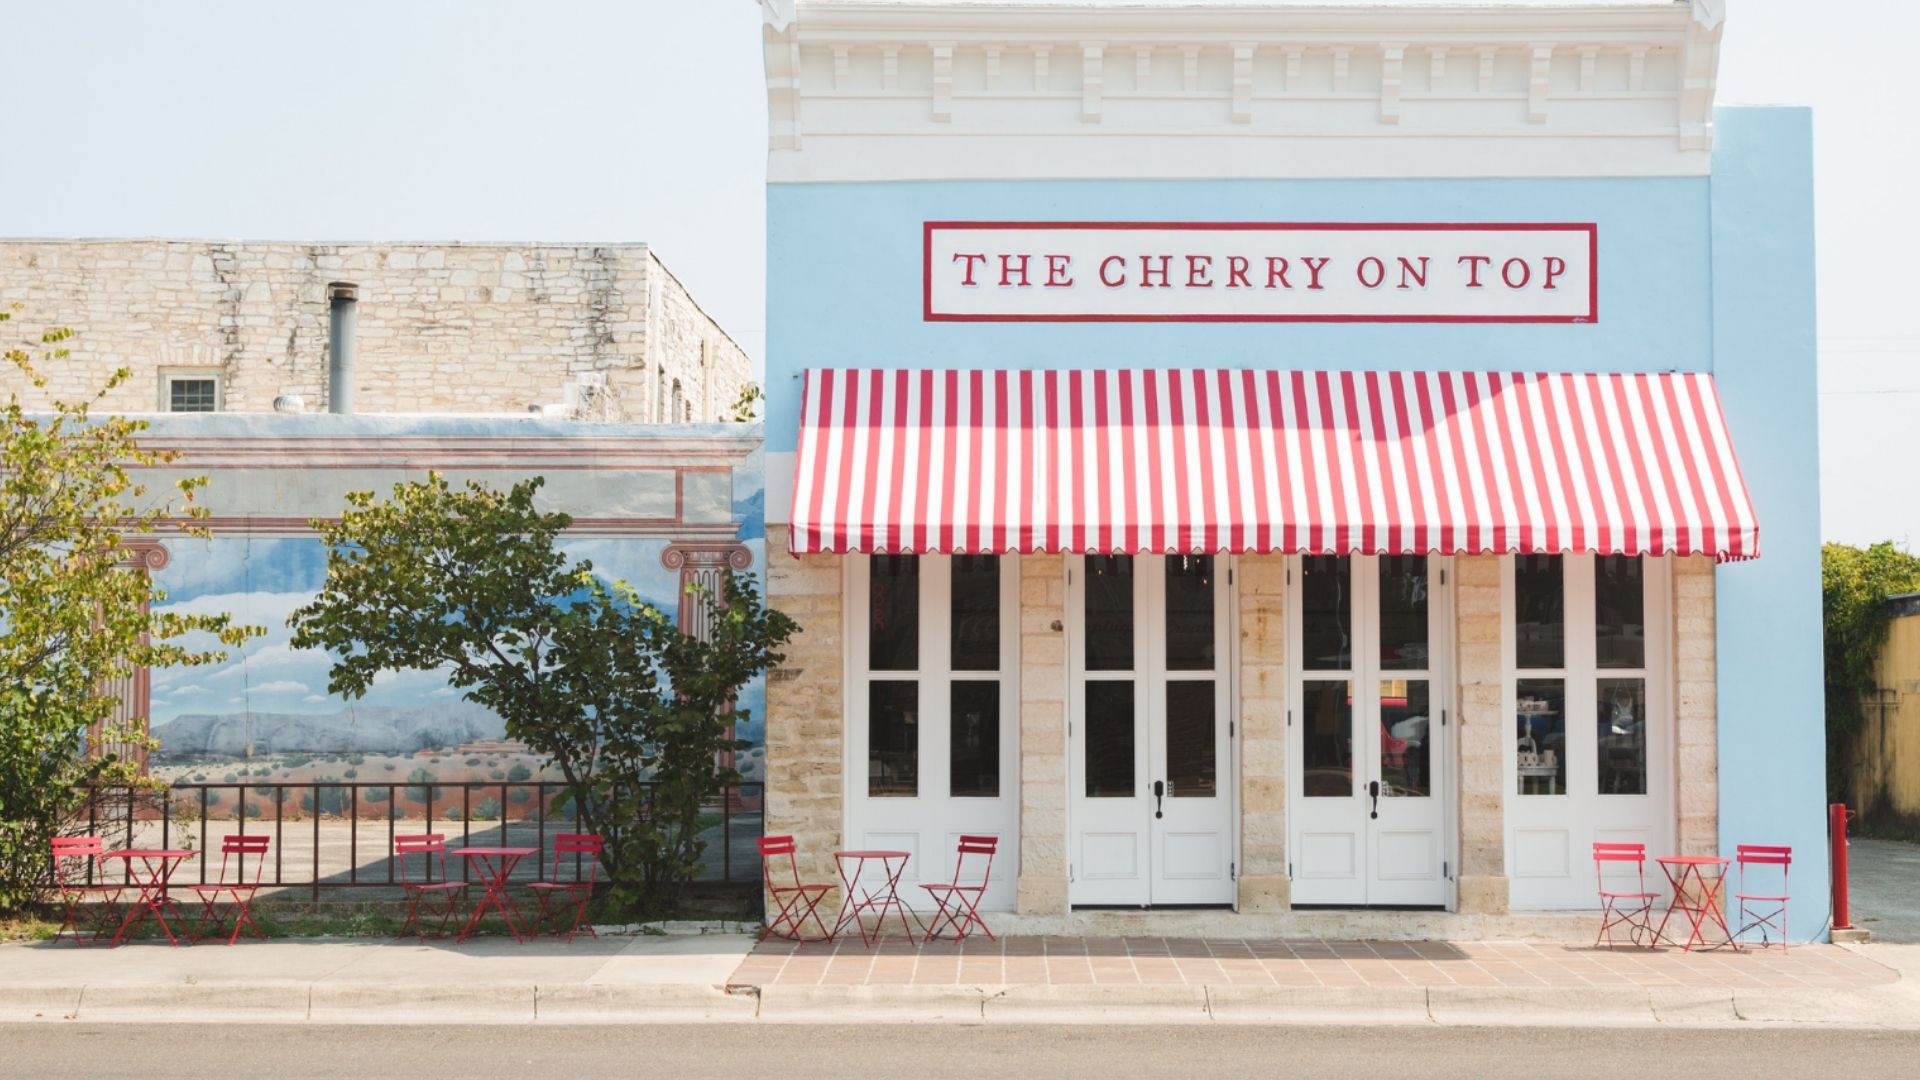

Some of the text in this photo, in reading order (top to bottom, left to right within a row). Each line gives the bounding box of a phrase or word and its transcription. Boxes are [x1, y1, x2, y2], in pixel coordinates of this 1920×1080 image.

[952, 253, 1567, 289] THE CHERRY ON TOP
